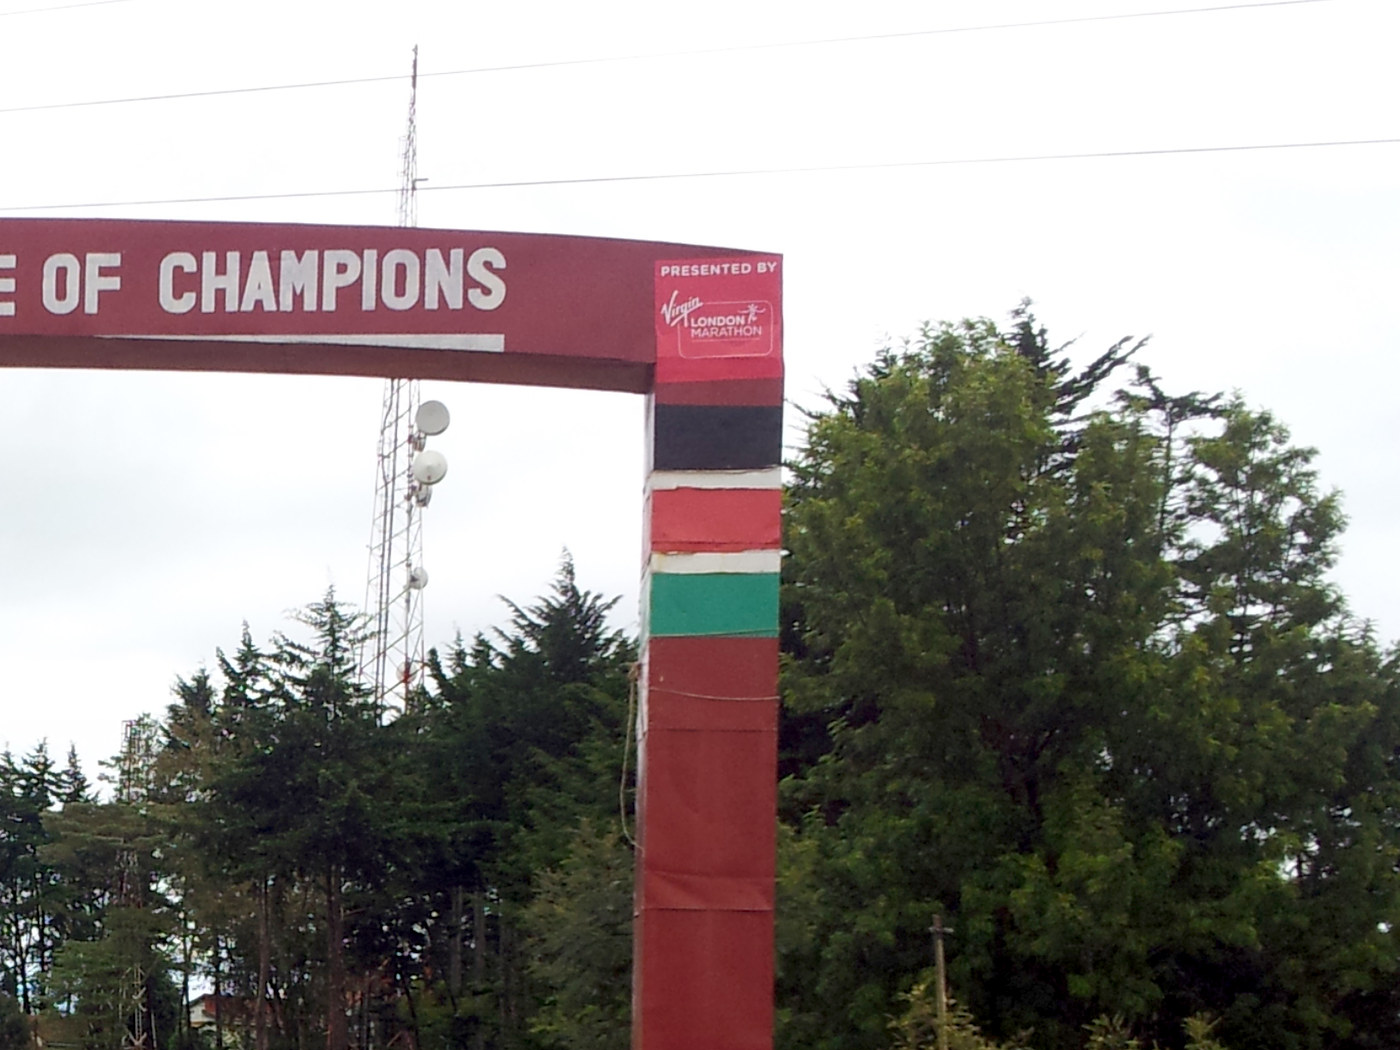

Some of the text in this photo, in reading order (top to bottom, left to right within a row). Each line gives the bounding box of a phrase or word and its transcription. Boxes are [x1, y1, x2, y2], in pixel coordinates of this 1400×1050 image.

[660, 261, 778, 277] PRESENTED BY
[42, 252, 122, 315] OF
[158, 247, 507, 314] CHAMPIONS
[660, 289, 704, 328] Virgin
[690, 315, 746, 328] LONDON
[690, 325, 763, 338] MARATHON
